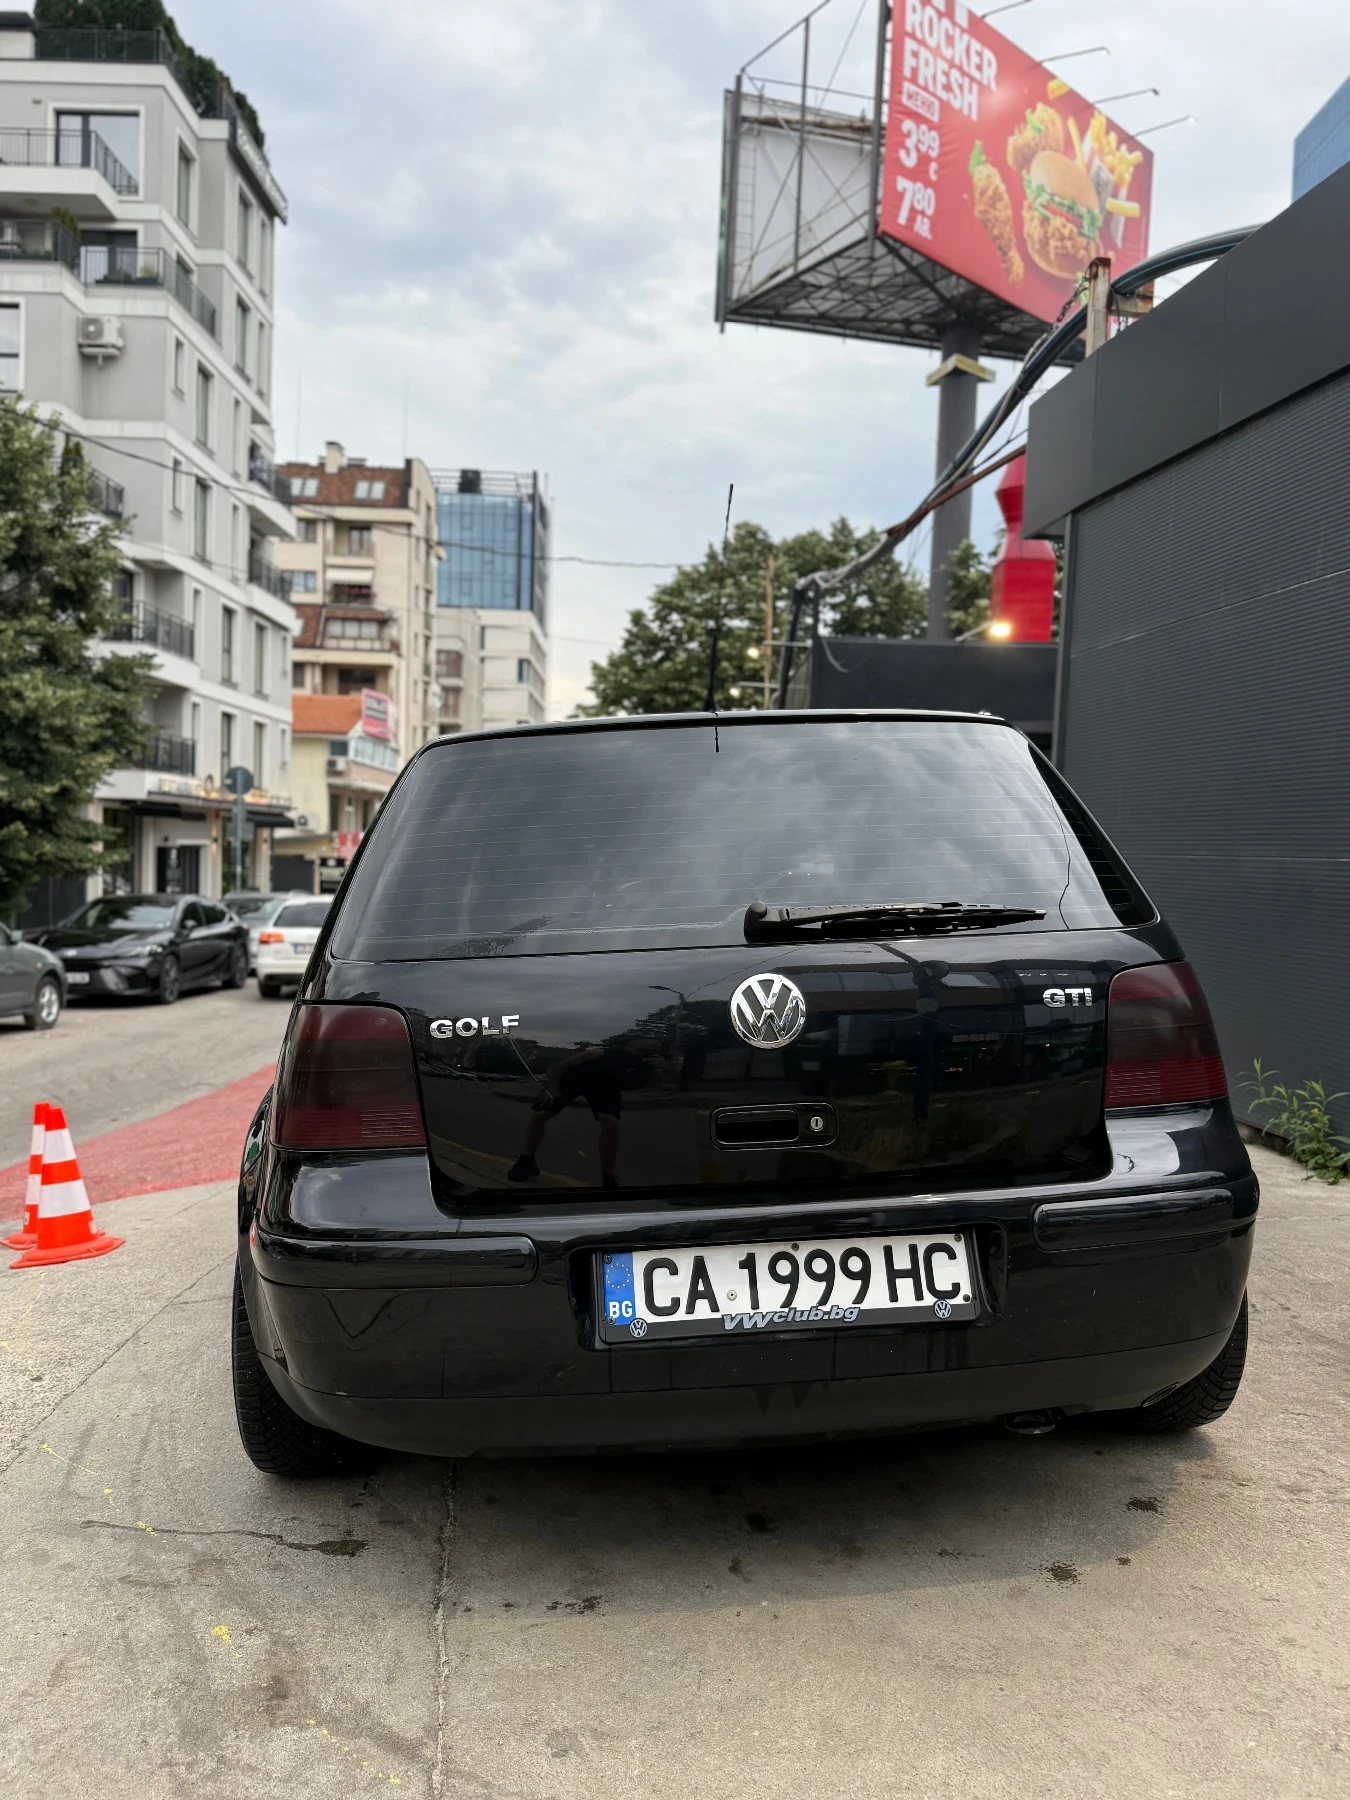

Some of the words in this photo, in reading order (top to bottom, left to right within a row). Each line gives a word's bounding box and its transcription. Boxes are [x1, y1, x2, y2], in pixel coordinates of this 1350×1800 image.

[904, 0, 998, 92] ROCKER
[903, 36, 979, 123] FRESH
[1043, 988, 1093, 1008] GTI
[429, 1014, 520, 1039] GOLF
[643, 1255, 720, 1316] CA
[738, 1247, 872, 1311] 1999
[883, 1242, 961, 1303] HC
[609, 1300, 633, 1319] BG
